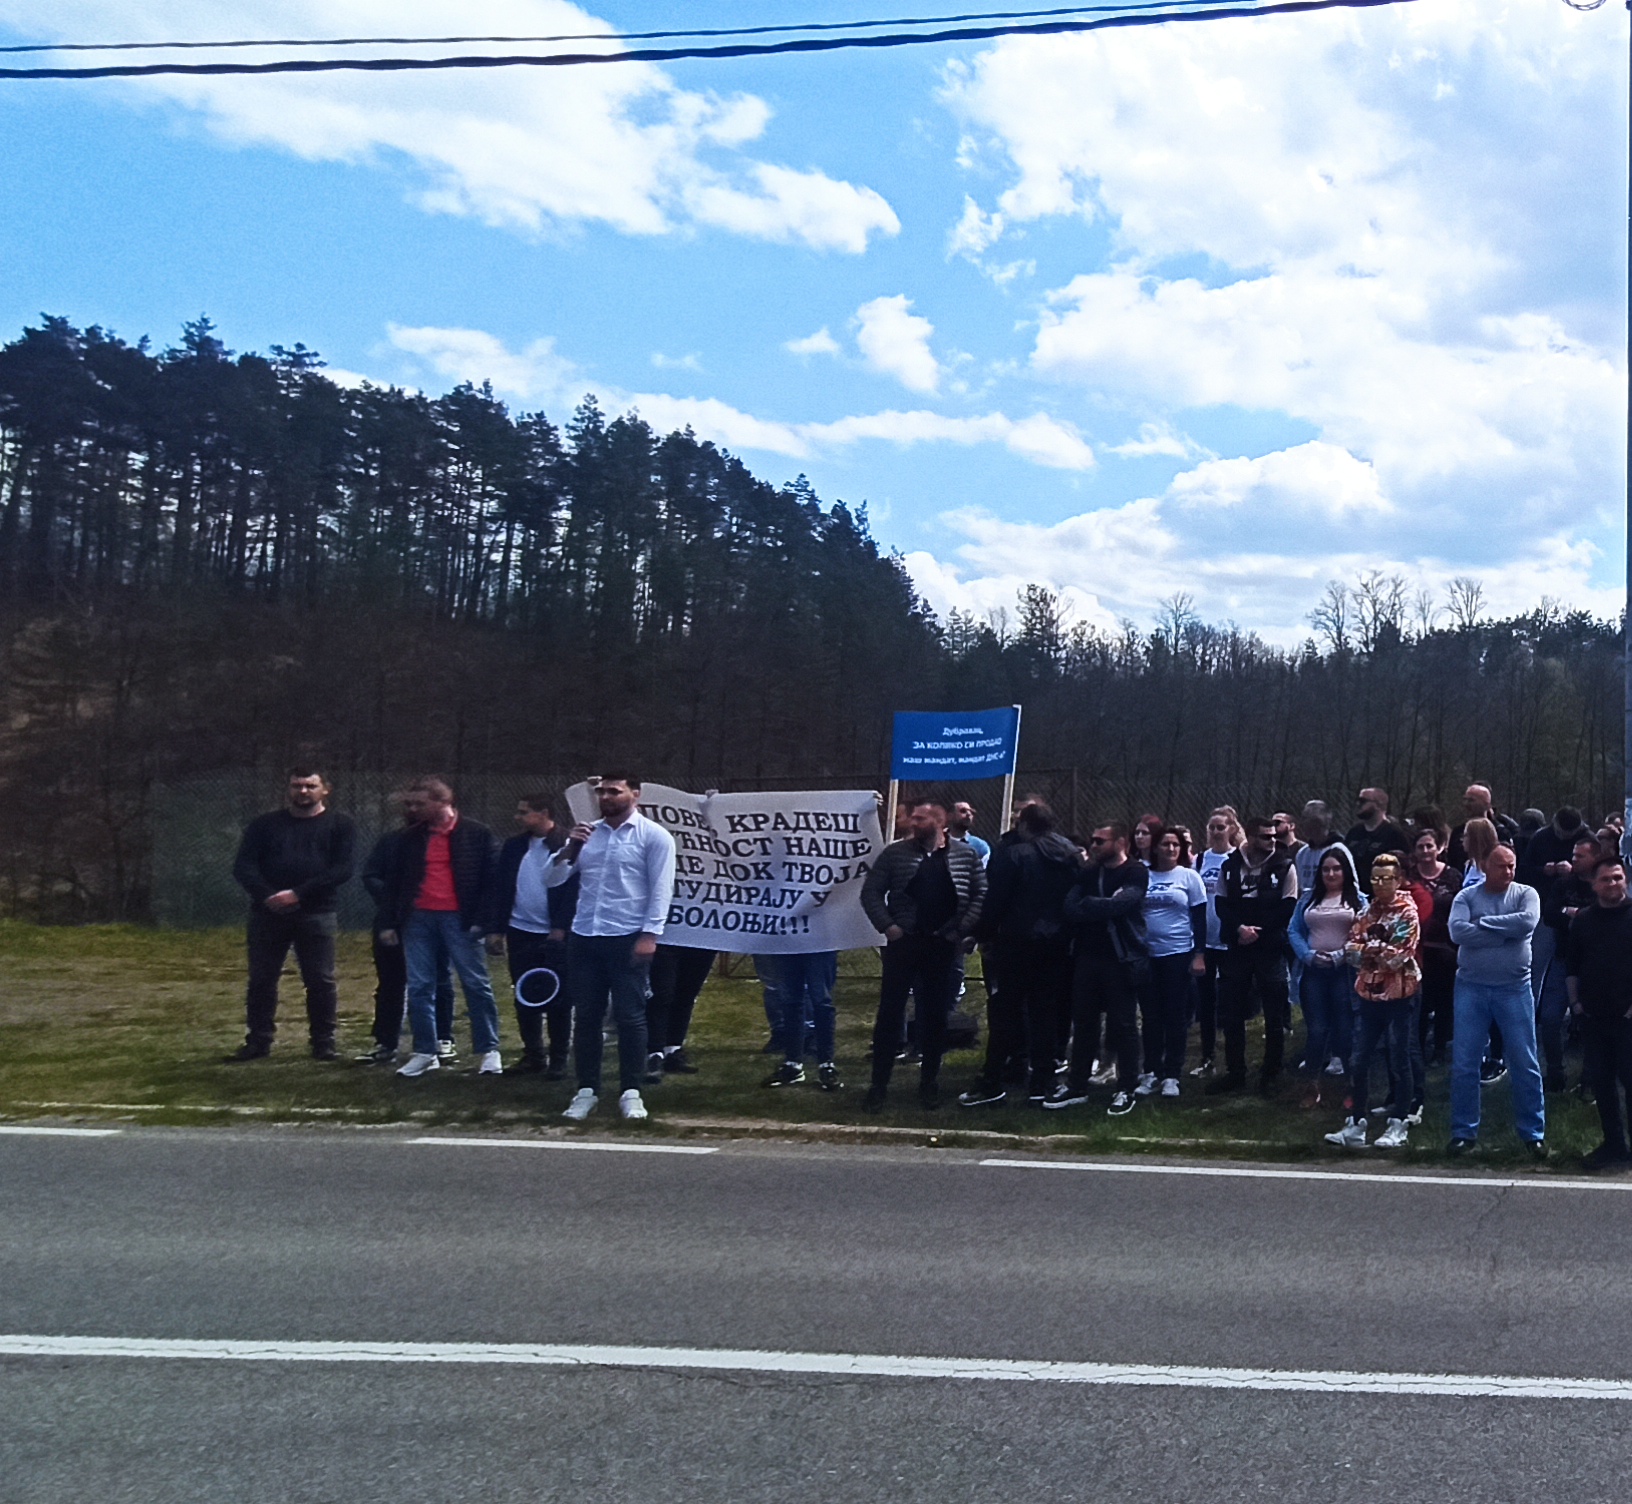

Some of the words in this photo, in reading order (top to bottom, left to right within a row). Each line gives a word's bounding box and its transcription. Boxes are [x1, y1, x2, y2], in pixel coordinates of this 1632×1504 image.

[912, 741, 925, 749] ЗА
[926, 741, 963, 749] КОЛИКО
[964, 741, 975, 749] СИ
[725, 811, 861, 834] КРАДЕШ
[669, 830, 773, 857] ЋНОСТ
[783, 837, 872, 859] НАШЕ
[713, 860, 774, 882] ДОК
[782, 861, 871, 885] ТВОЈА
[673, 879, 804, 909] ТУДИРАЈУ
[811, 890, 831, 907] У
[666, 904, 810, 935] БОЛОЊИ!!!
